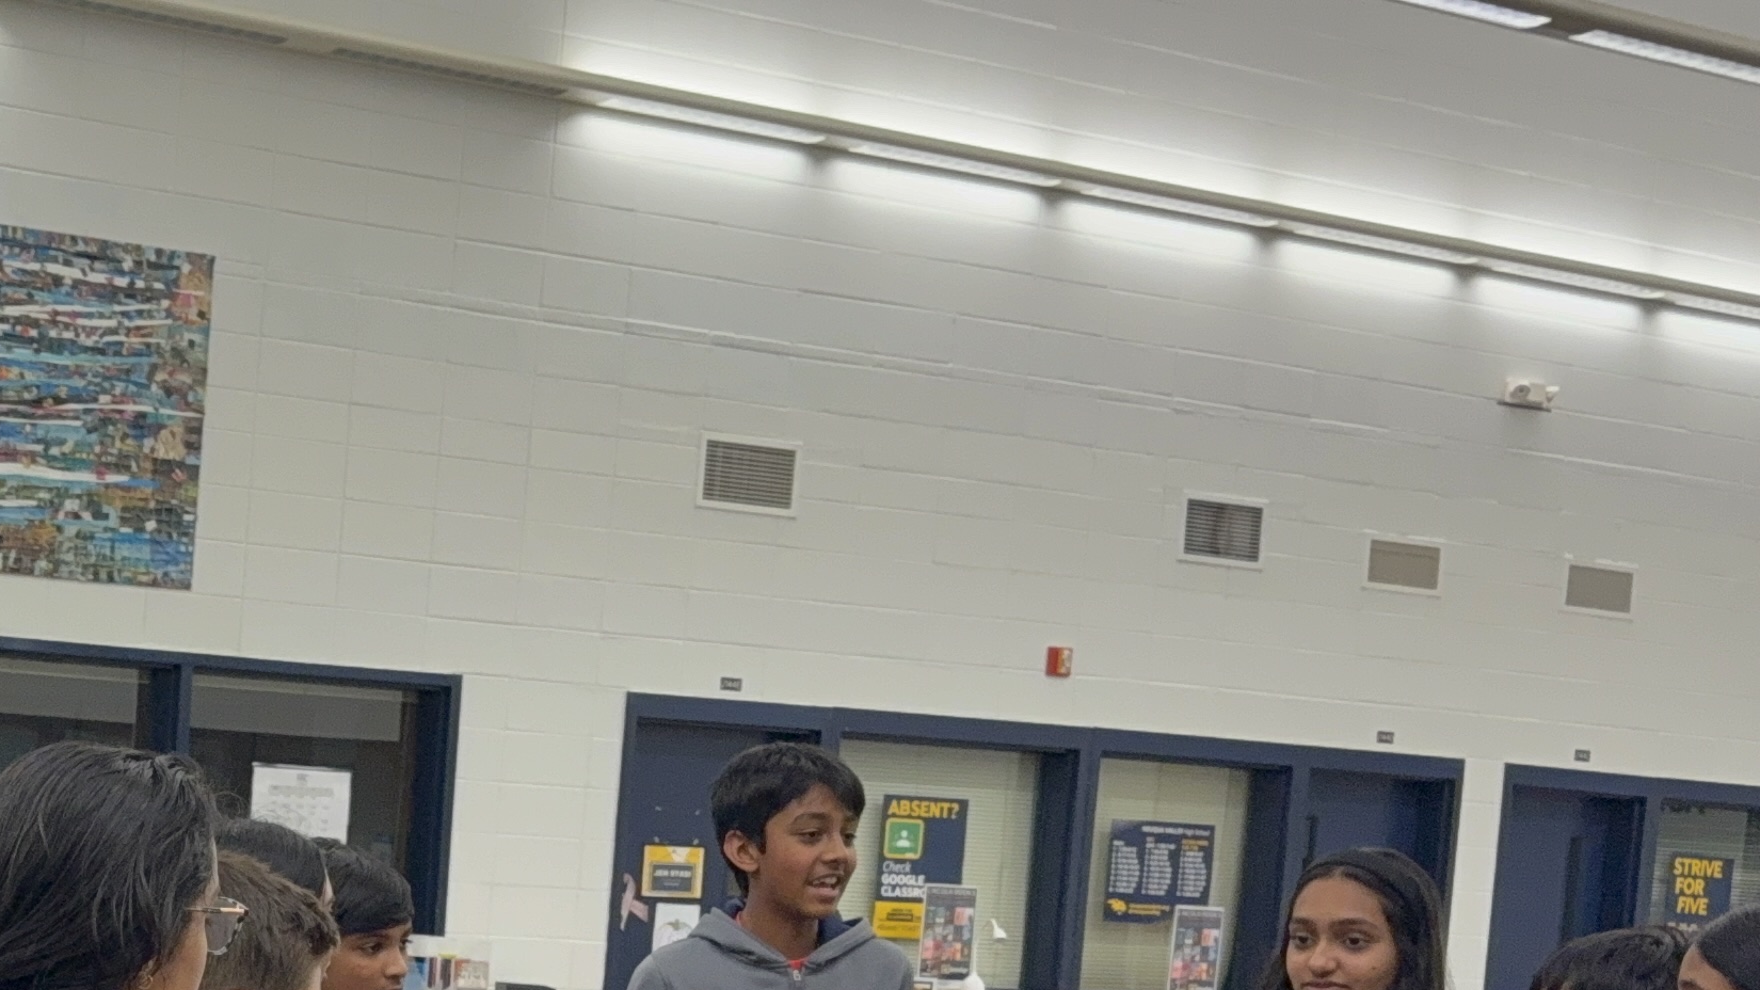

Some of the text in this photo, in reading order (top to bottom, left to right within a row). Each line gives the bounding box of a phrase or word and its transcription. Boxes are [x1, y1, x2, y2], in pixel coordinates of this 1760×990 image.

[888, 799, 960, 819] ABSENT?
[882, 860, 912, 873] Check
[1673, 857, 1723, 879] STRIVE
[881, 873, 926, 886] GOOGLE
[1674, 876, 1705, 896] FOR
[1676, 895, 1709, 916] FIVE
